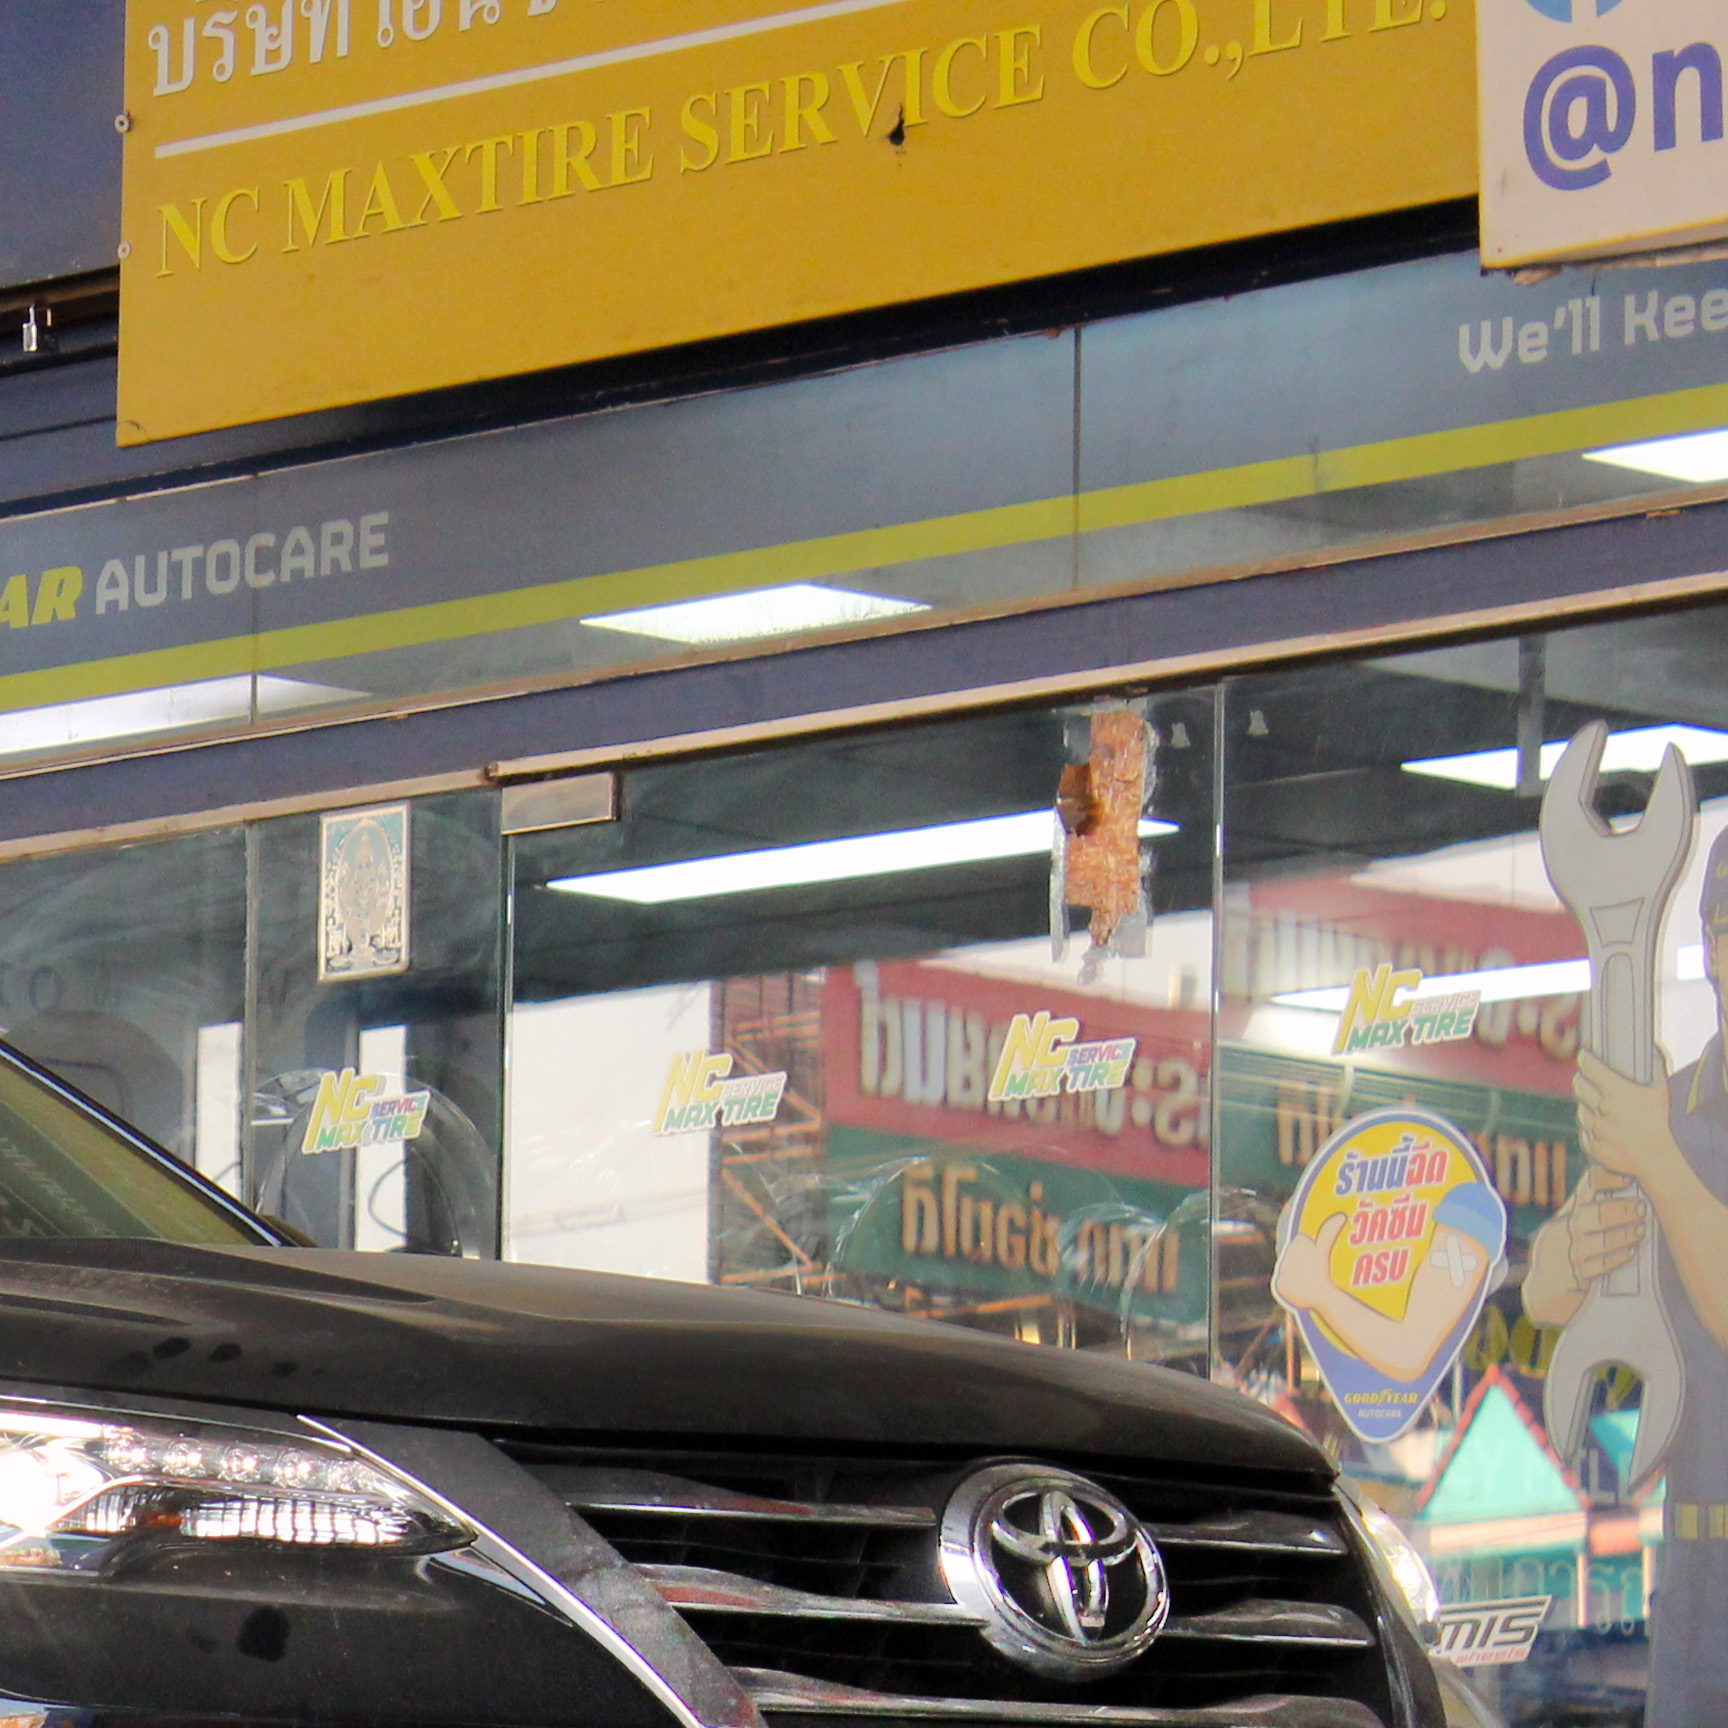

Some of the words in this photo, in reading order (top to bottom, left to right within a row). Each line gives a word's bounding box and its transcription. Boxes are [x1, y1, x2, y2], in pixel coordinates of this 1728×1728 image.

[155, 188, 261, 278] NC
[281, 105, 654, 254] MAXTIRE
[679, 22, 1044, 174] SERVICE
[1457, 286, 1601, 374] We'll
[94, 510, 390, 616] AUTOCARE
[1333, 965, 1423, 1054] NC
[1349, 1019, 1408, 1050] MAX
[1409, 1009, 1473, 1042] TIRE
[991, 1013, 1079, 1098] NC
[1004, 1067, 1063, 1097] MAX
[1066, 1060, 1127, 1090] TIRE
[1066, 1041, 1134, 1066] SERVICE
[304, 1068, 378, 1152] NC
[653, 1051, 733, 1134] NC
[664, 1101, 718, 1131] MAX
[722, 1091, 777, 1124] TIRE
[318, 1123, 368, 1151] MAX
[371, 1111, 423, 1142] TIRE
[1349, 1194, 1428, 1246] วัคซีน
[1344, 1389, 1419, 1405] GOODYEAR
